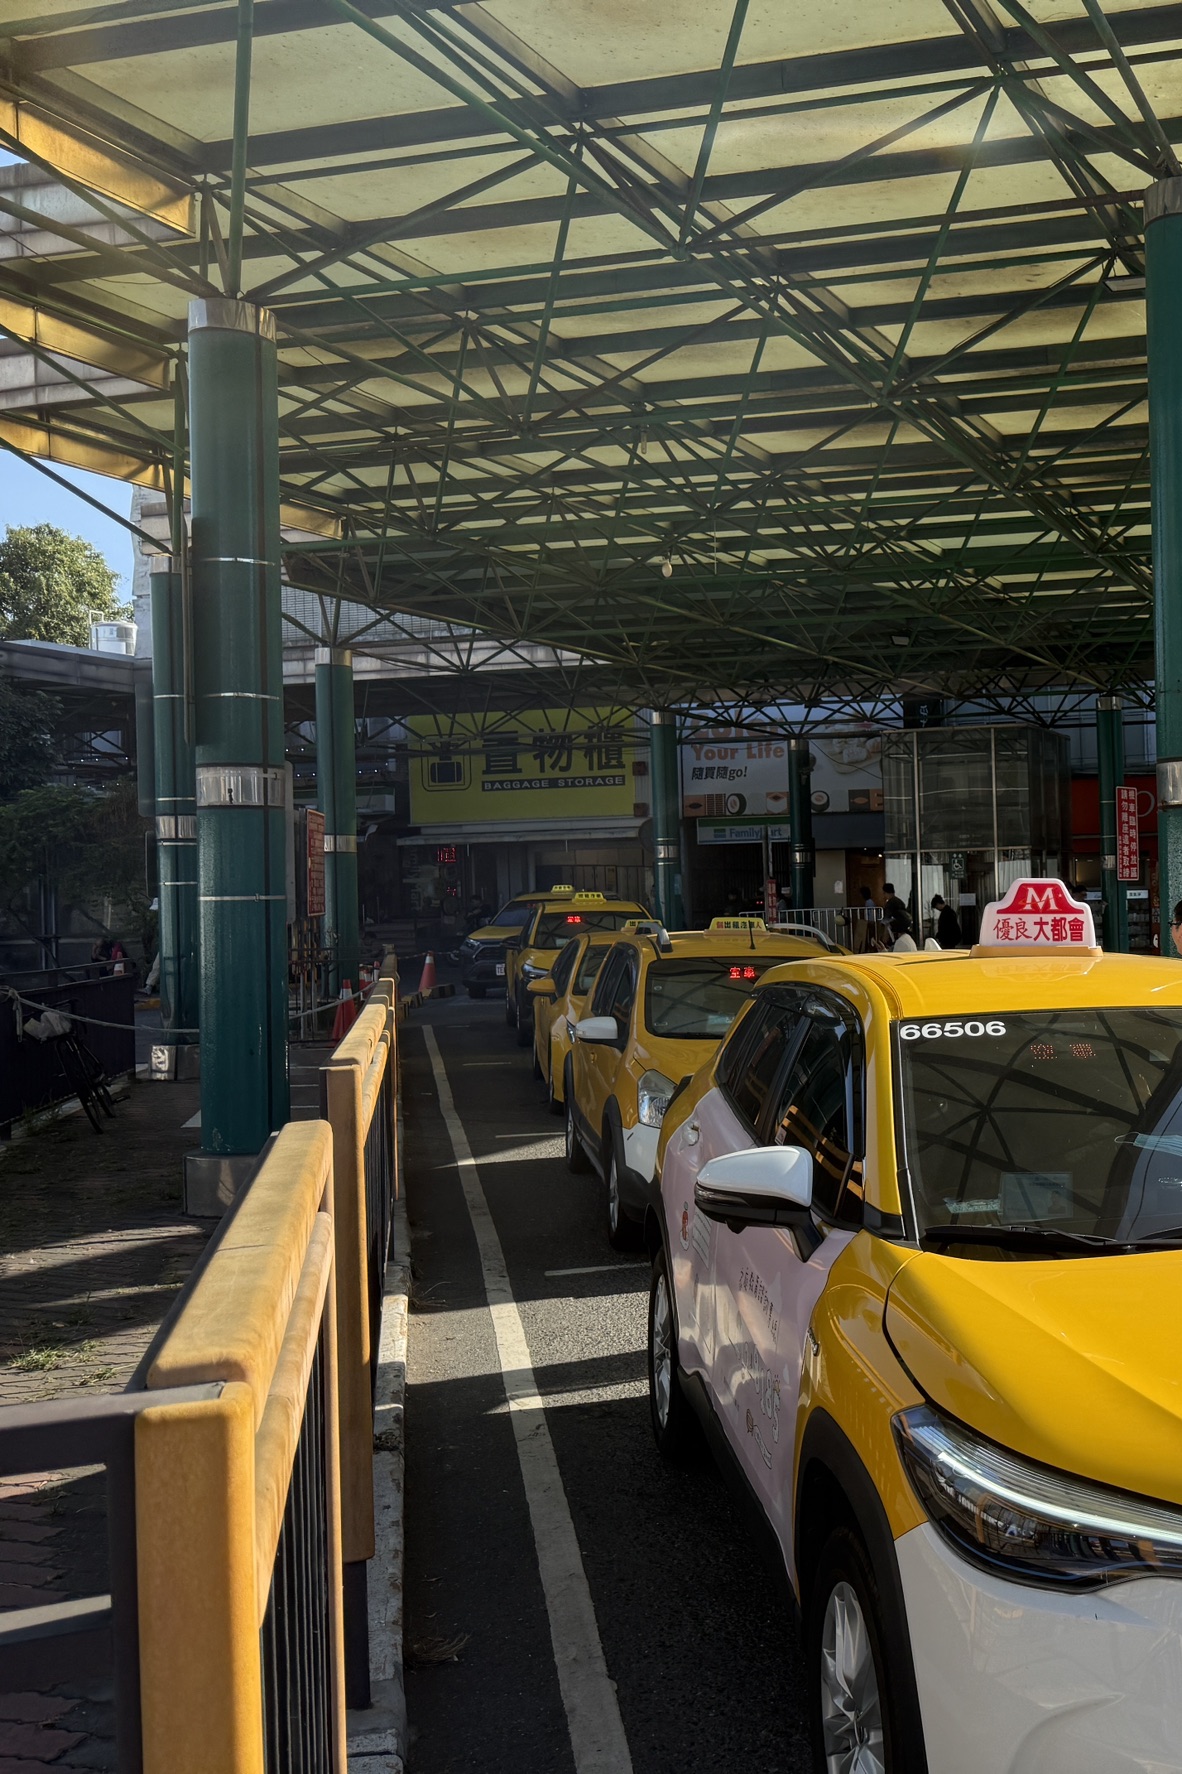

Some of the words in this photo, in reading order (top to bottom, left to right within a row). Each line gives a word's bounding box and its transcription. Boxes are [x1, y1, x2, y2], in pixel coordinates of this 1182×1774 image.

[482, 725, 626, 775] 置物櫃
[691, 743, 738, 761] Your
[746, 741, 785, 760] Life
[484, 779, 550, 790] BAGGAGE
[558, 776, 624, 787] STORAGE
[691, 766, 748, 781] 隨買隨go!
[1023, 886, 1060, 911] M
[899, 1020, 1007, 1040] 66506
